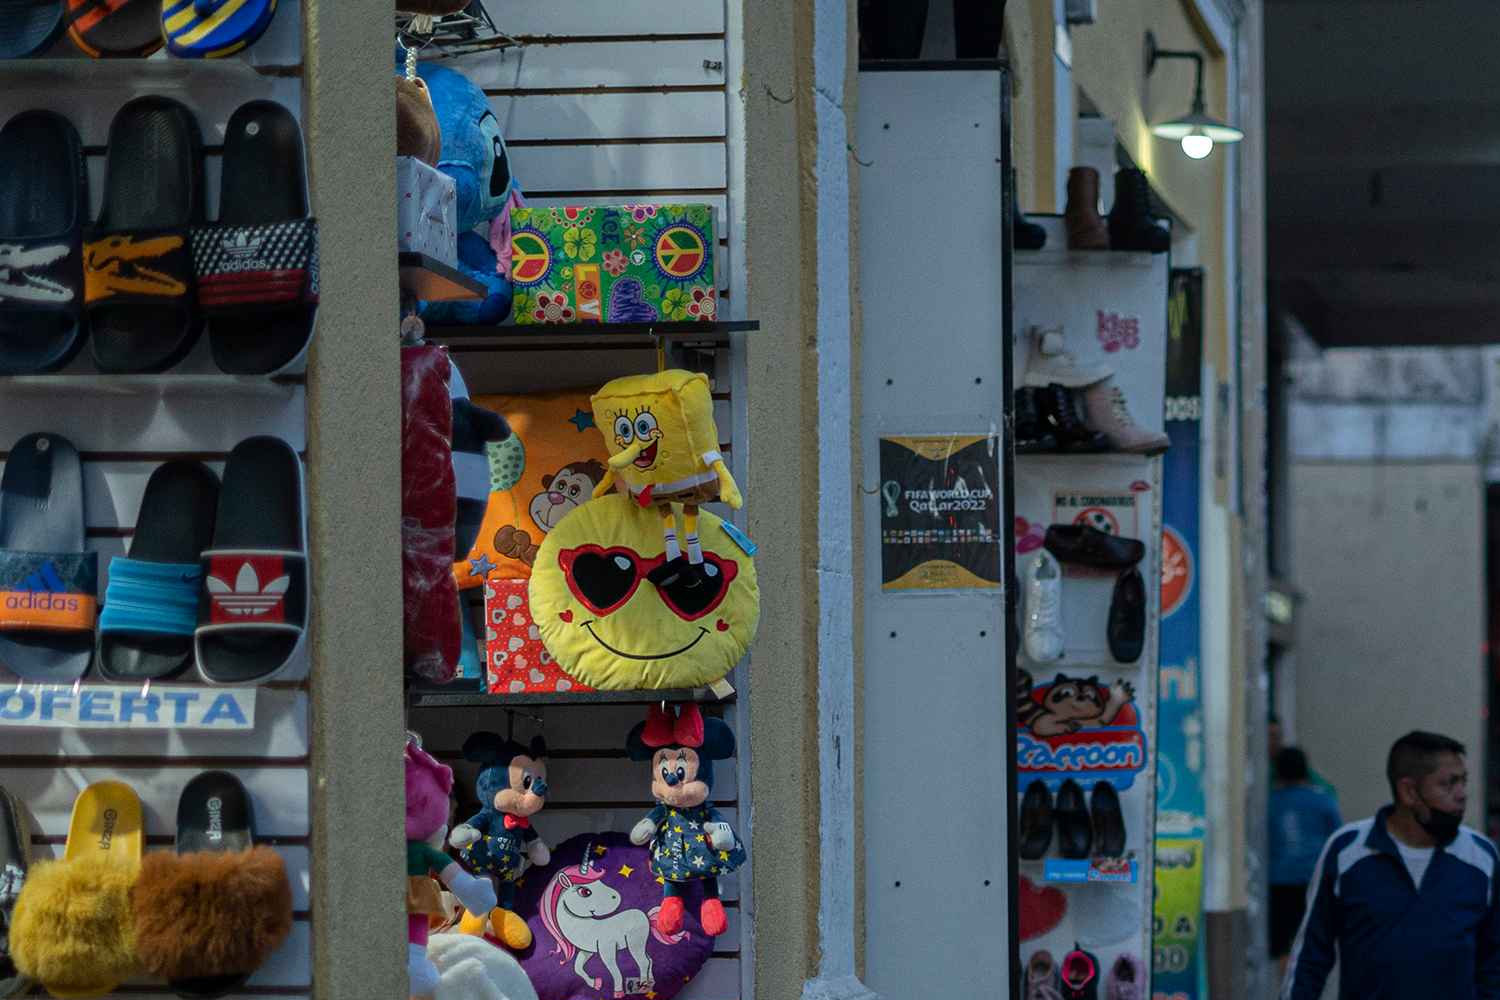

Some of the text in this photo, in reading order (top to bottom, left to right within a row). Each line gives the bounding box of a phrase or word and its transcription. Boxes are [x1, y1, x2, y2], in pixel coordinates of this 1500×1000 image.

[221, 258, 266, 273] adidas
[905, 489, 929, 500] FIFA
[929, 489, 969, 500] WORLD
[6, 590, 79, 612] adidas
[0, 689, 249, 725] OFERTA
[98, 808, 118, 850] GINZA
